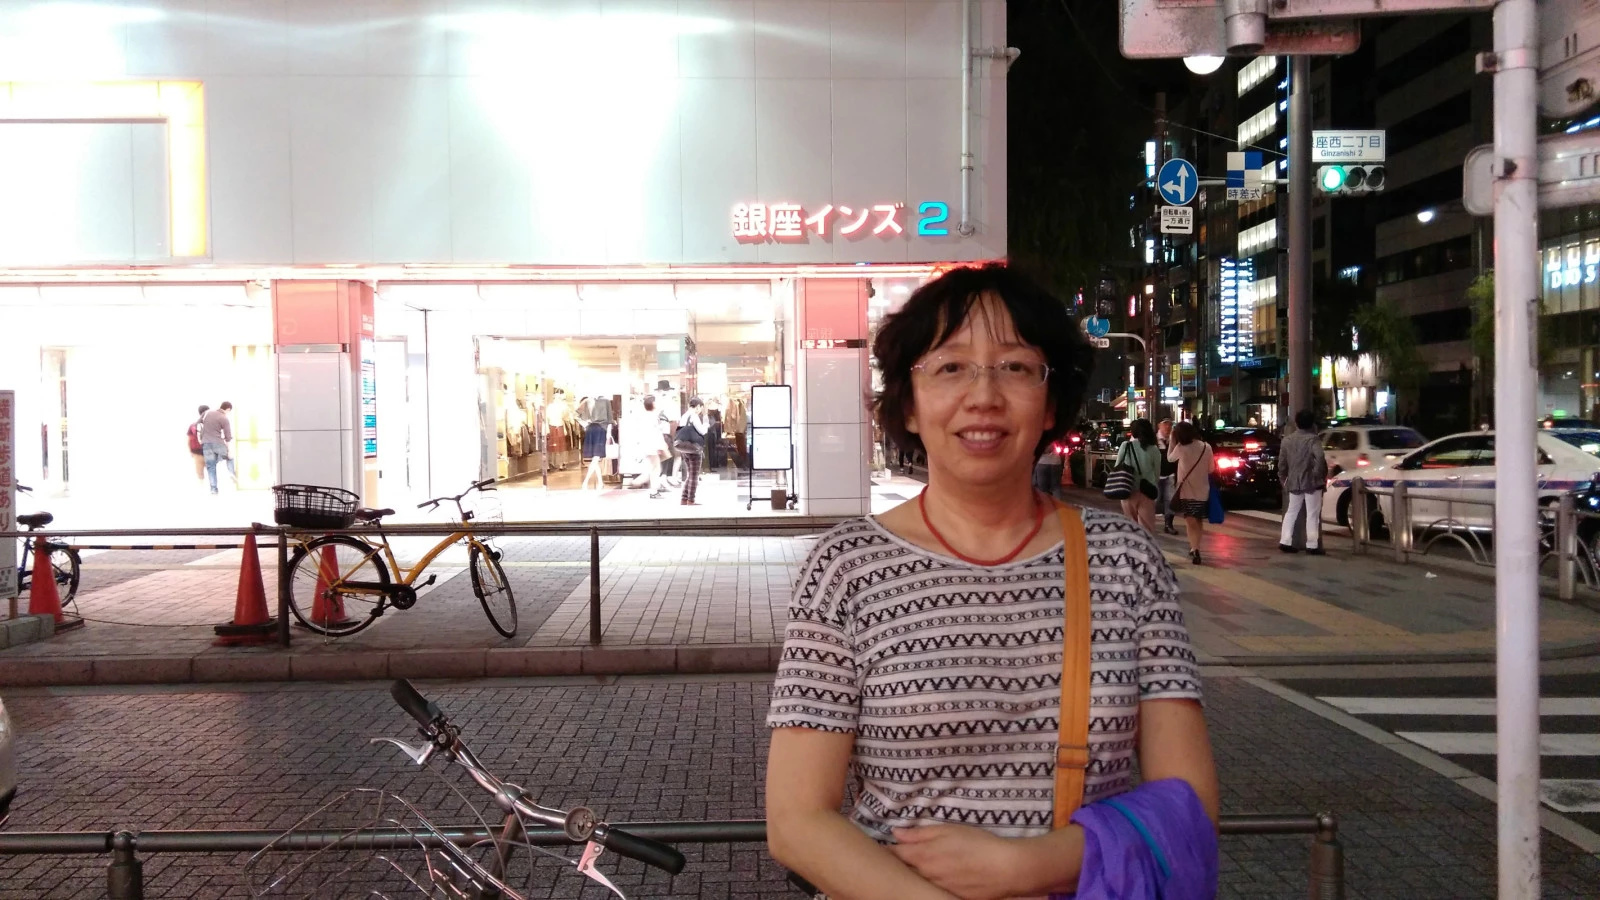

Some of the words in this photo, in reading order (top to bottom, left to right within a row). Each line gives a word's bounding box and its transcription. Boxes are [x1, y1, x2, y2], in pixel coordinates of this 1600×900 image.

[1312, 136, 1380, 149] 座西二丁目
[1320, 149, 1356, 157] Ginzanishi
[1358, 149, 1363, 157] 2
[1227, 188, 1261, 199] 時差式
[733, 201, 904, 238] 銀座インズ
[917, 201, 949, 236] 2
[1163, 217, 1191, 225] 一方通行
